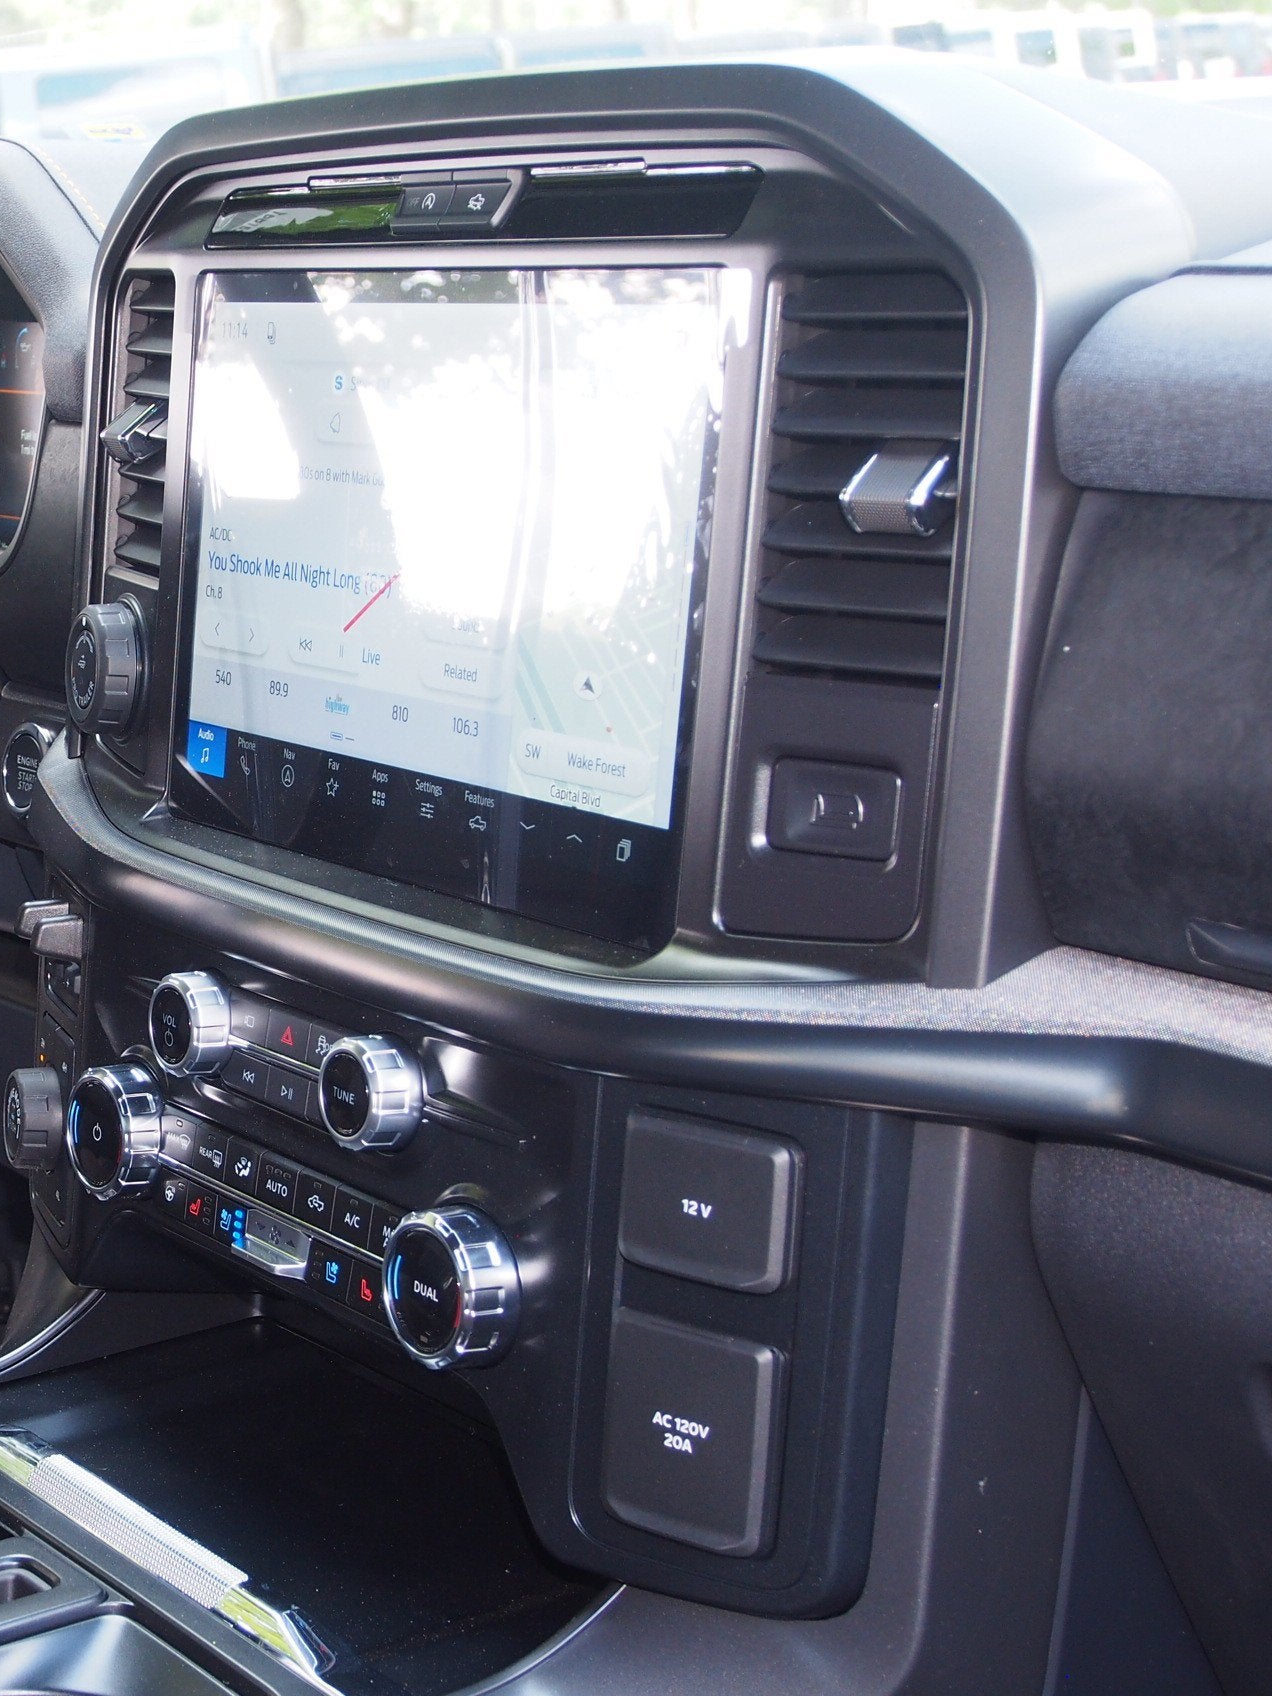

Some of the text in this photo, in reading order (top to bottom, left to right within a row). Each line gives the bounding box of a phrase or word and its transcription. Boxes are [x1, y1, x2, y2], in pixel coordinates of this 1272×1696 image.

[222, 322, 248, 339] 11:14
[315, 471, 325, 481] on
[326, 468, 331, 481] 8
[332, 469, 350, 484] with
[352, 470, 370, 485] Mark
[209, 527, 232, 542] AC/DC
[208, 551, 227, 571] You
[229, 554, 262, 577] Shook
[264, 559, 280, 579] Me
[283, 562, 298, 582] All
[300, 564, 330, 588] Night
[333, 569, 361, 595] Long
[362, 648, 381, 666] Live
[215, 670, 232, 686] 540
[443, 663, 478, 682] Related
[269, 681, 289, 697] 89.9
[391, 705, 409, 722] 810
[198, 728, 215, 741] Audio
[453, 717, 479, 737] 106.3
[237, 737, 256, 751] Phone
[525, 743, 541, 759] SW
[17, 754, 39, 768] ENGINE
[283, 748, 296, 761] Nav
[328, 758, 340, 771] Fav
[567, 752, 626, 778] Wake Forest
[371, 769, 389, 783] Apps
[17, 781, 33, 791] STOP
[415, 778, 443, 797] Settings
[464, 790, 495, 808] Features
[550, 784, 601, 808] Capital Blvd
[162, 1013, 176, 1028] VOL
[333, 1086, 355, 1106] TUNE
[199, 1146, 213, 1158] REAR
[265, 1179, 288, 1198] AUTO
[681, 1199, 712, 1218] 12 V
[344, 1212, 360, 1229] A/C
[413, 1280, 439, 1303] DUAL
[651, 1411, 710, 1439] AC 120V
[663, 1432, 693, 1454] 20A
